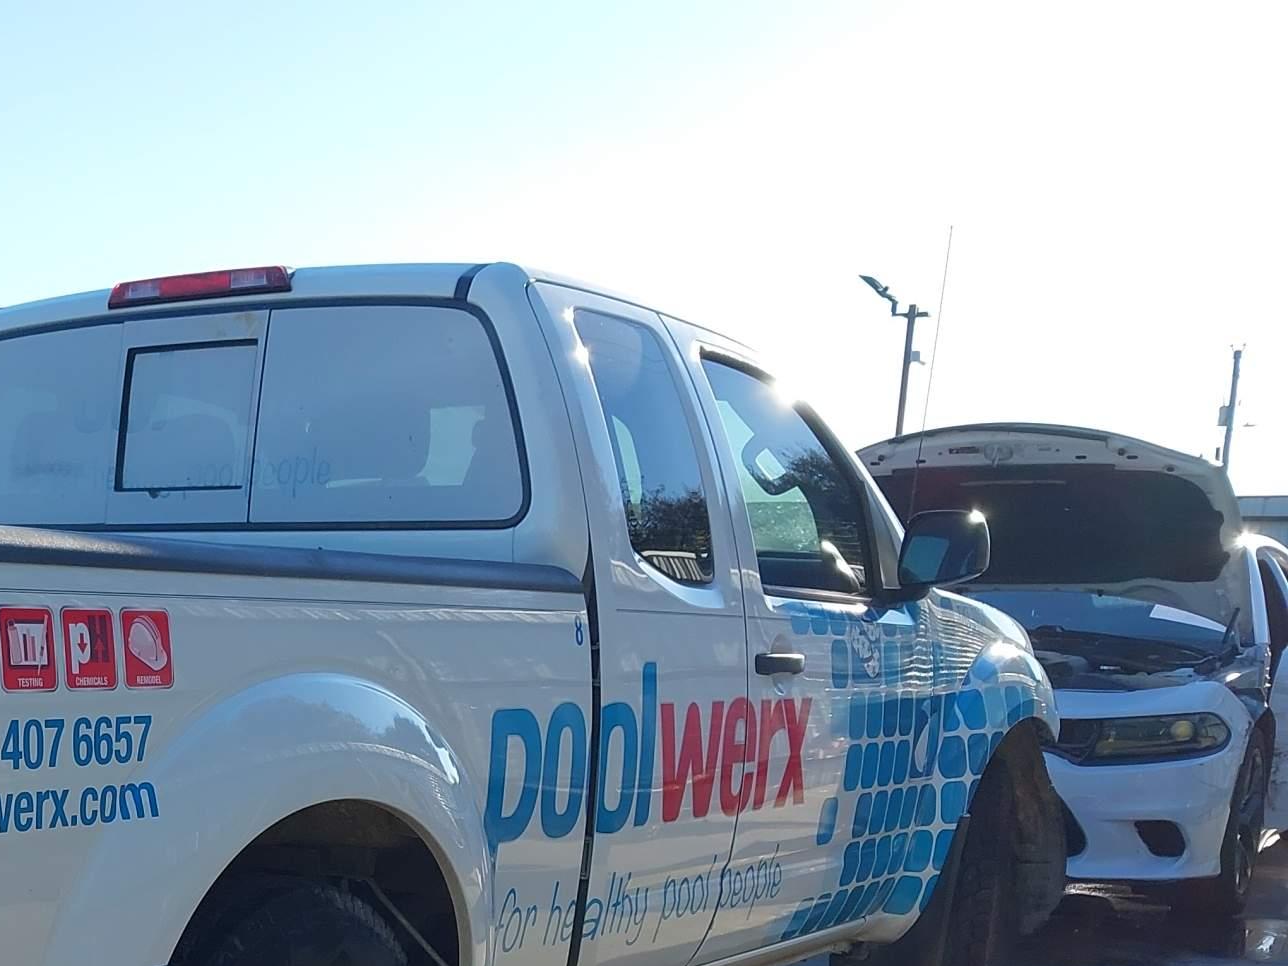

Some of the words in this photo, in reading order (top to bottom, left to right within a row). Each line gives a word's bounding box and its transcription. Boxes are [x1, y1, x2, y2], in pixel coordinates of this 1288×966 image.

[574, 617, 583, 646] 8
[17, 677, 44, 687] TESTING
[75, 676, 109, 686] CHEMICALS
[136, 675, 162, 684] REMODEL
[0, 718, 65, 770] 407
[72, 715, 153, 767] 6657
[483, 660, 813, 860] poolwerx
[495, 887, 537, 953] for
[543, 878, 650, 946] healthy
[652, 853, 718, 943] pool
[717, 842, 783, 921] people
